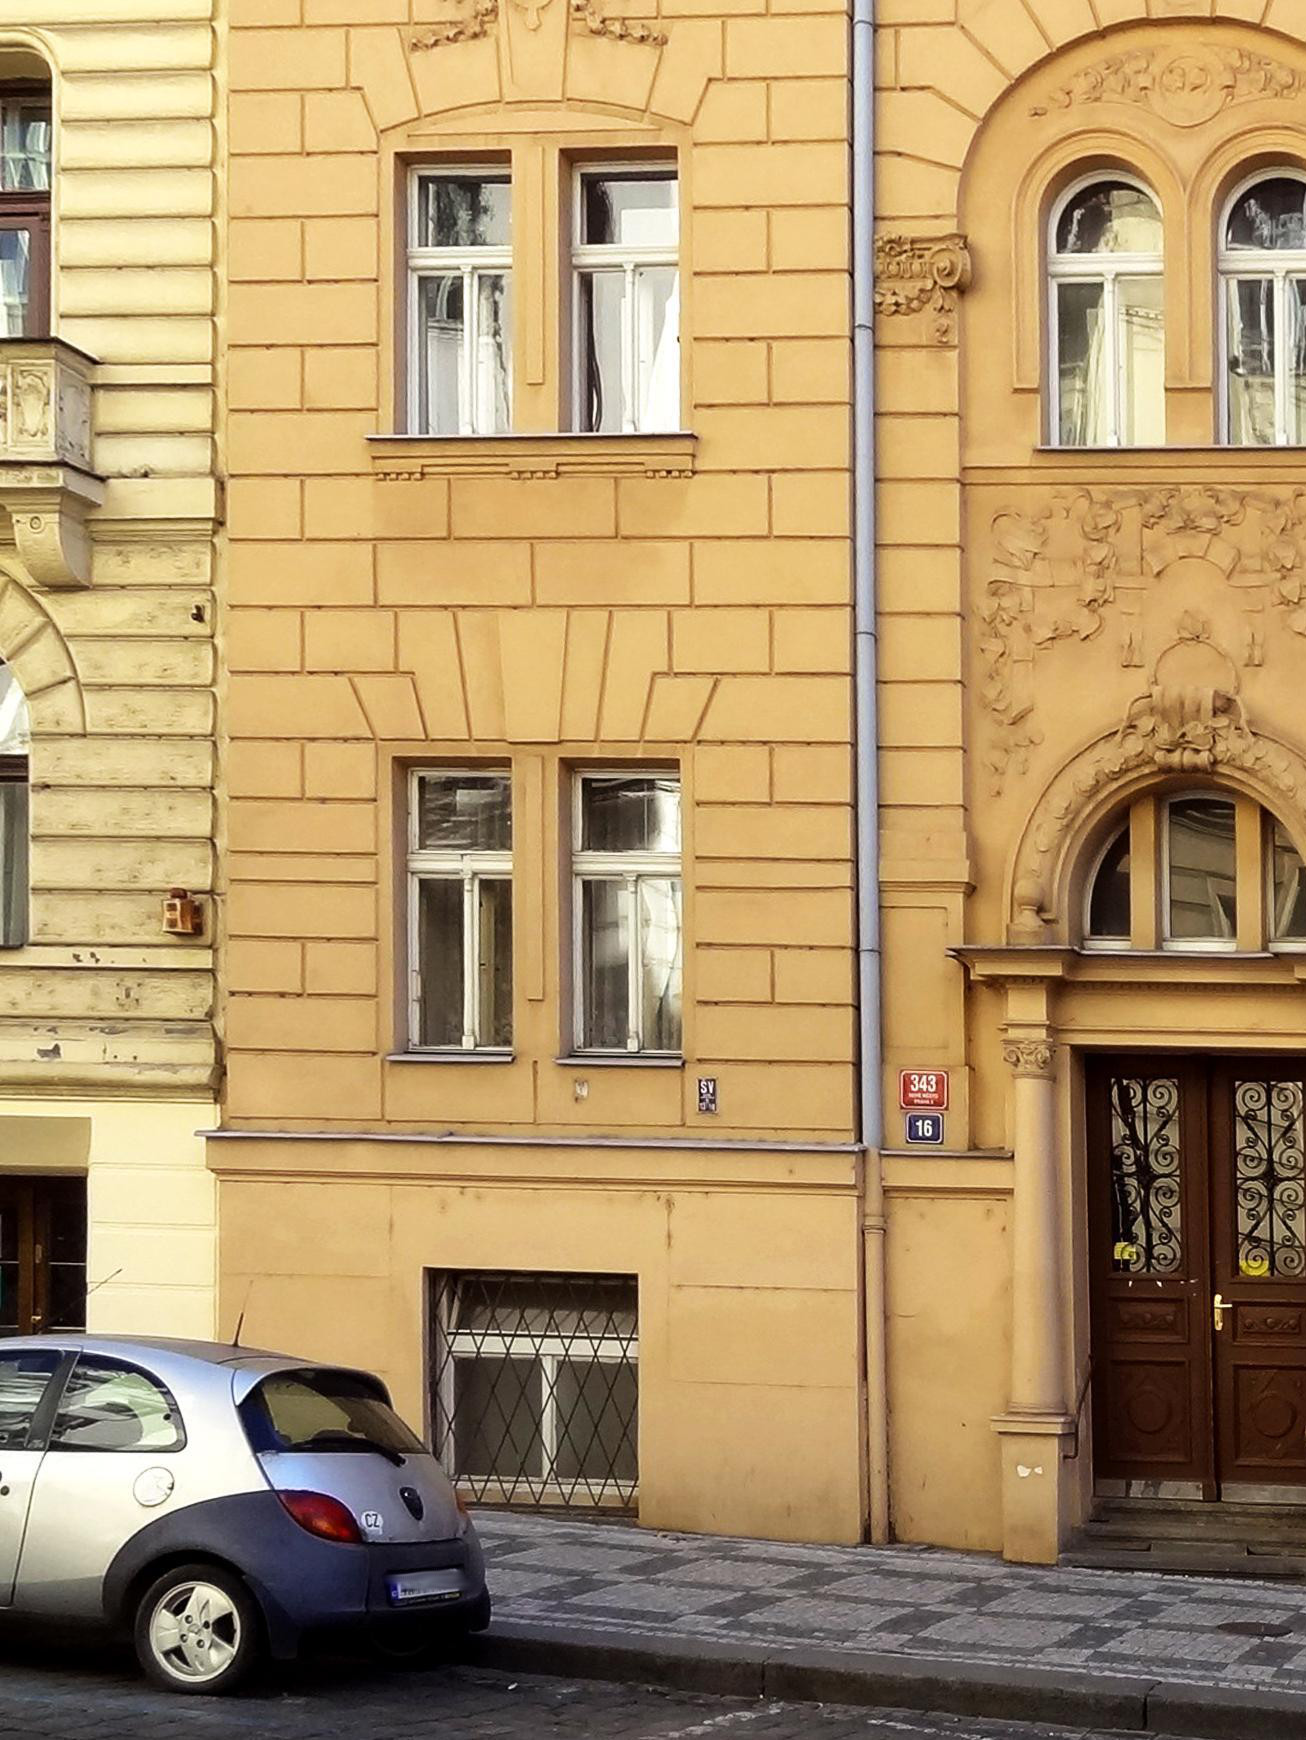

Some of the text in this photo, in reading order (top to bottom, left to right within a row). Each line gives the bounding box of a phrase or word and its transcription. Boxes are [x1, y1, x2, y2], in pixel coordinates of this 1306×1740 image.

[911, 1074, 936, 1092] 343
[915, 1119, 933, 1137] 16
[365, 1513, 380, 1528] CZ
